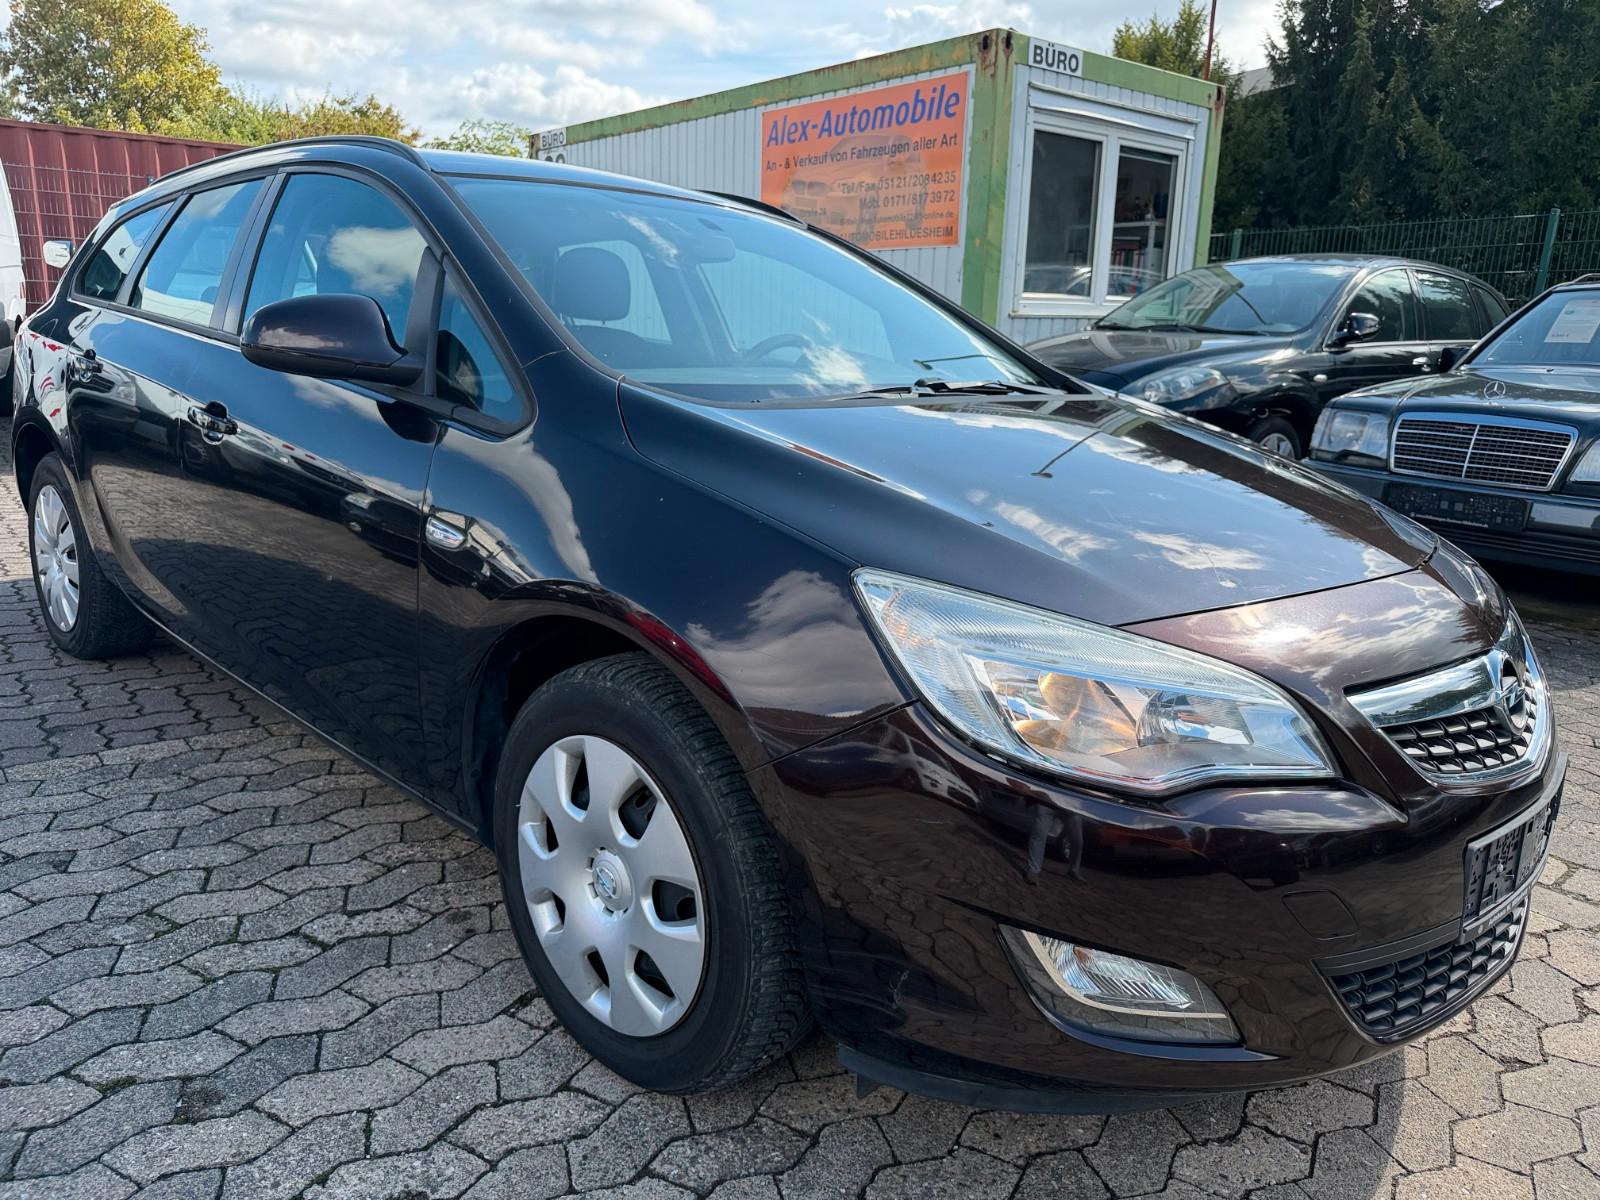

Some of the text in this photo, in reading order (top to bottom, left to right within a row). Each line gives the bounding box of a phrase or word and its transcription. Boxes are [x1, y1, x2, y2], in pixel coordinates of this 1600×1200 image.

[1032, 42, 1079, 73] BÜRO
[766, 84, 961, 147] Alex-Automobile
[793, 151, 828, 168] Verkauf
[830, 151, 848, 163] von
[850, 141, 910, 160] Fahrzeugen
[912, 137, 937, 151] aller
[940, 133, 958, 147] Art
